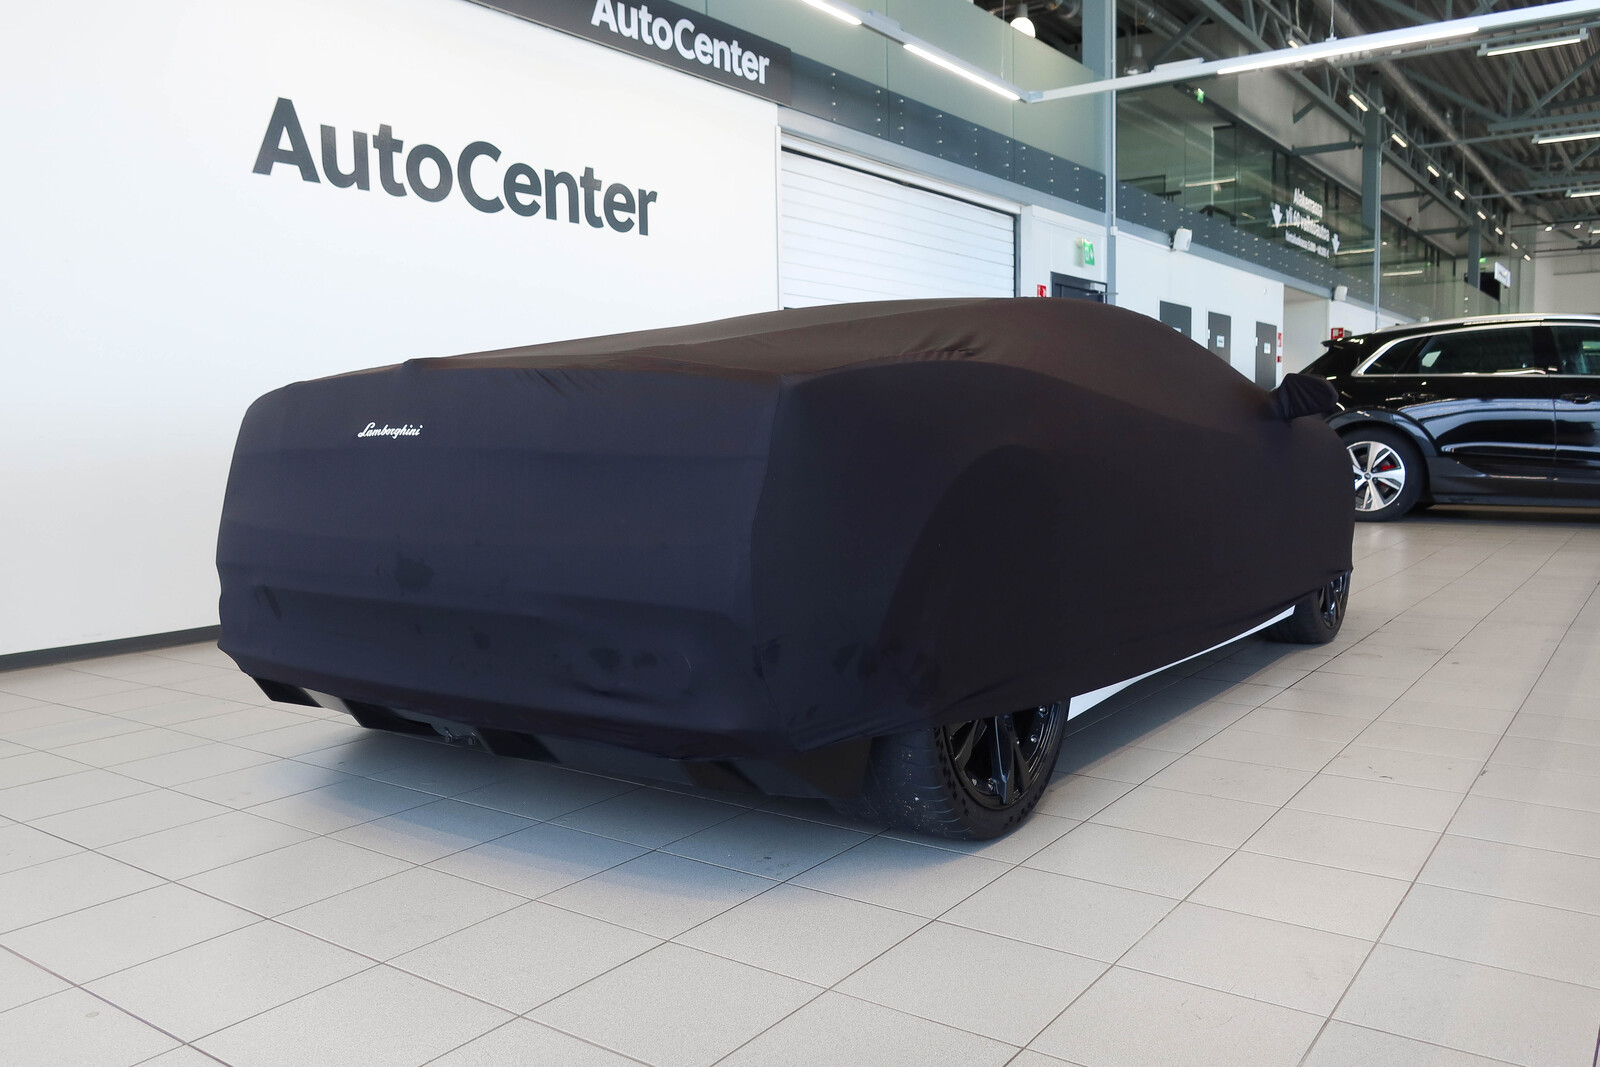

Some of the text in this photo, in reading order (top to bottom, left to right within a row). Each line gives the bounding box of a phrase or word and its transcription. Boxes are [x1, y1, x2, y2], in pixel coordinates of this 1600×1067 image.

[590, 0, 770, 85] AutoCenter
[252, 97, 658, 236] AutoCenter
[357, 421, 424, 440] Lamborghini
